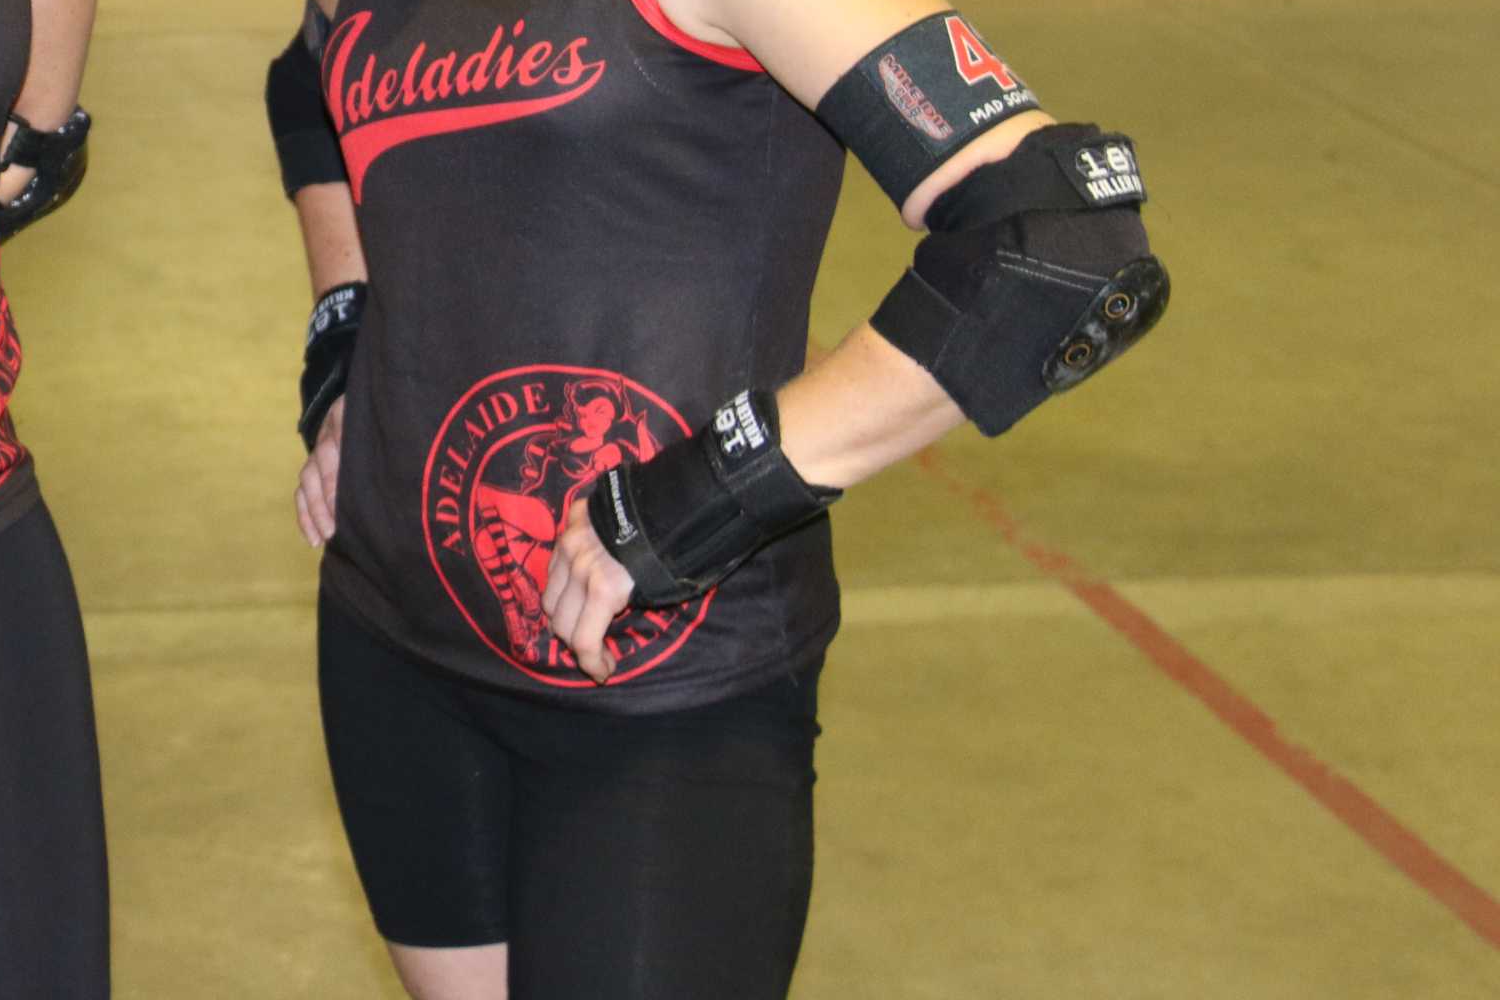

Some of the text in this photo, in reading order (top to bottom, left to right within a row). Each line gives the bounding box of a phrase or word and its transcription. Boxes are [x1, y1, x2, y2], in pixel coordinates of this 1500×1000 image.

[945, 16, 1018, 91] 4
[969, 99, 1004, 126] MAD
[435, 381, 550, 556] ADELAIDE
